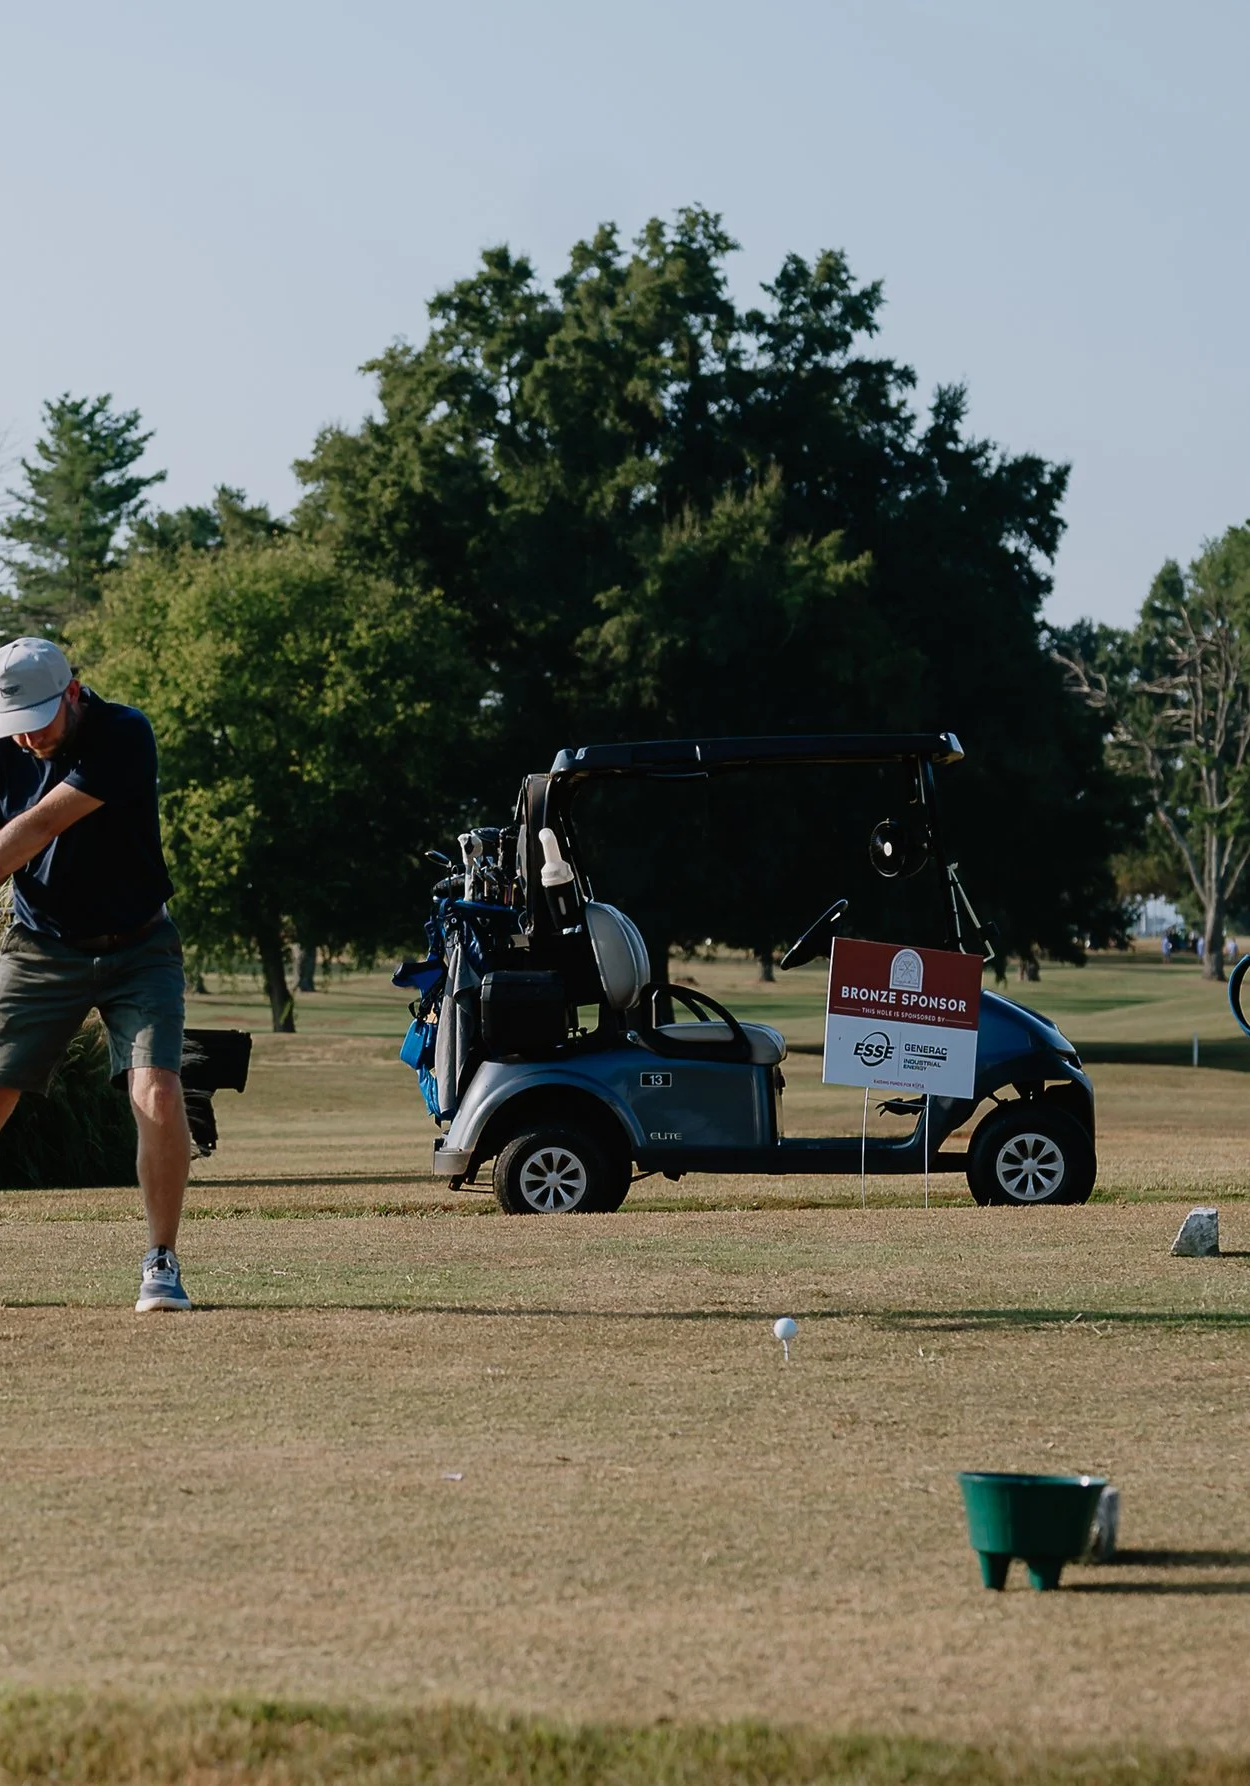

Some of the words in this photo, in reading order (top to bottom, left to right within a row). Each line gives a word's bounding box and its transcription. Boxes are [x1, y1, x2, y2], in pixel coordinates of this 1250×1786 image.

[841, 986, 897, 1003] BRONZE
[901, 993, 966, 1012] SPONSOR
[862, 1007, 876, 1015] THIS
[901, 1013, 936, 1022] SPONSORED
[853, 1042, 895, 1060] ESSE
[904, 1043, 948, 1056] GENERAC
[903, 1058, 942, 1068] INDUSTRIAL
[903, 1064, 928, 1072] ENERGY
[650, 1074, 663, 1086] 13
[650, 1132, 682, 1140] ELITE
